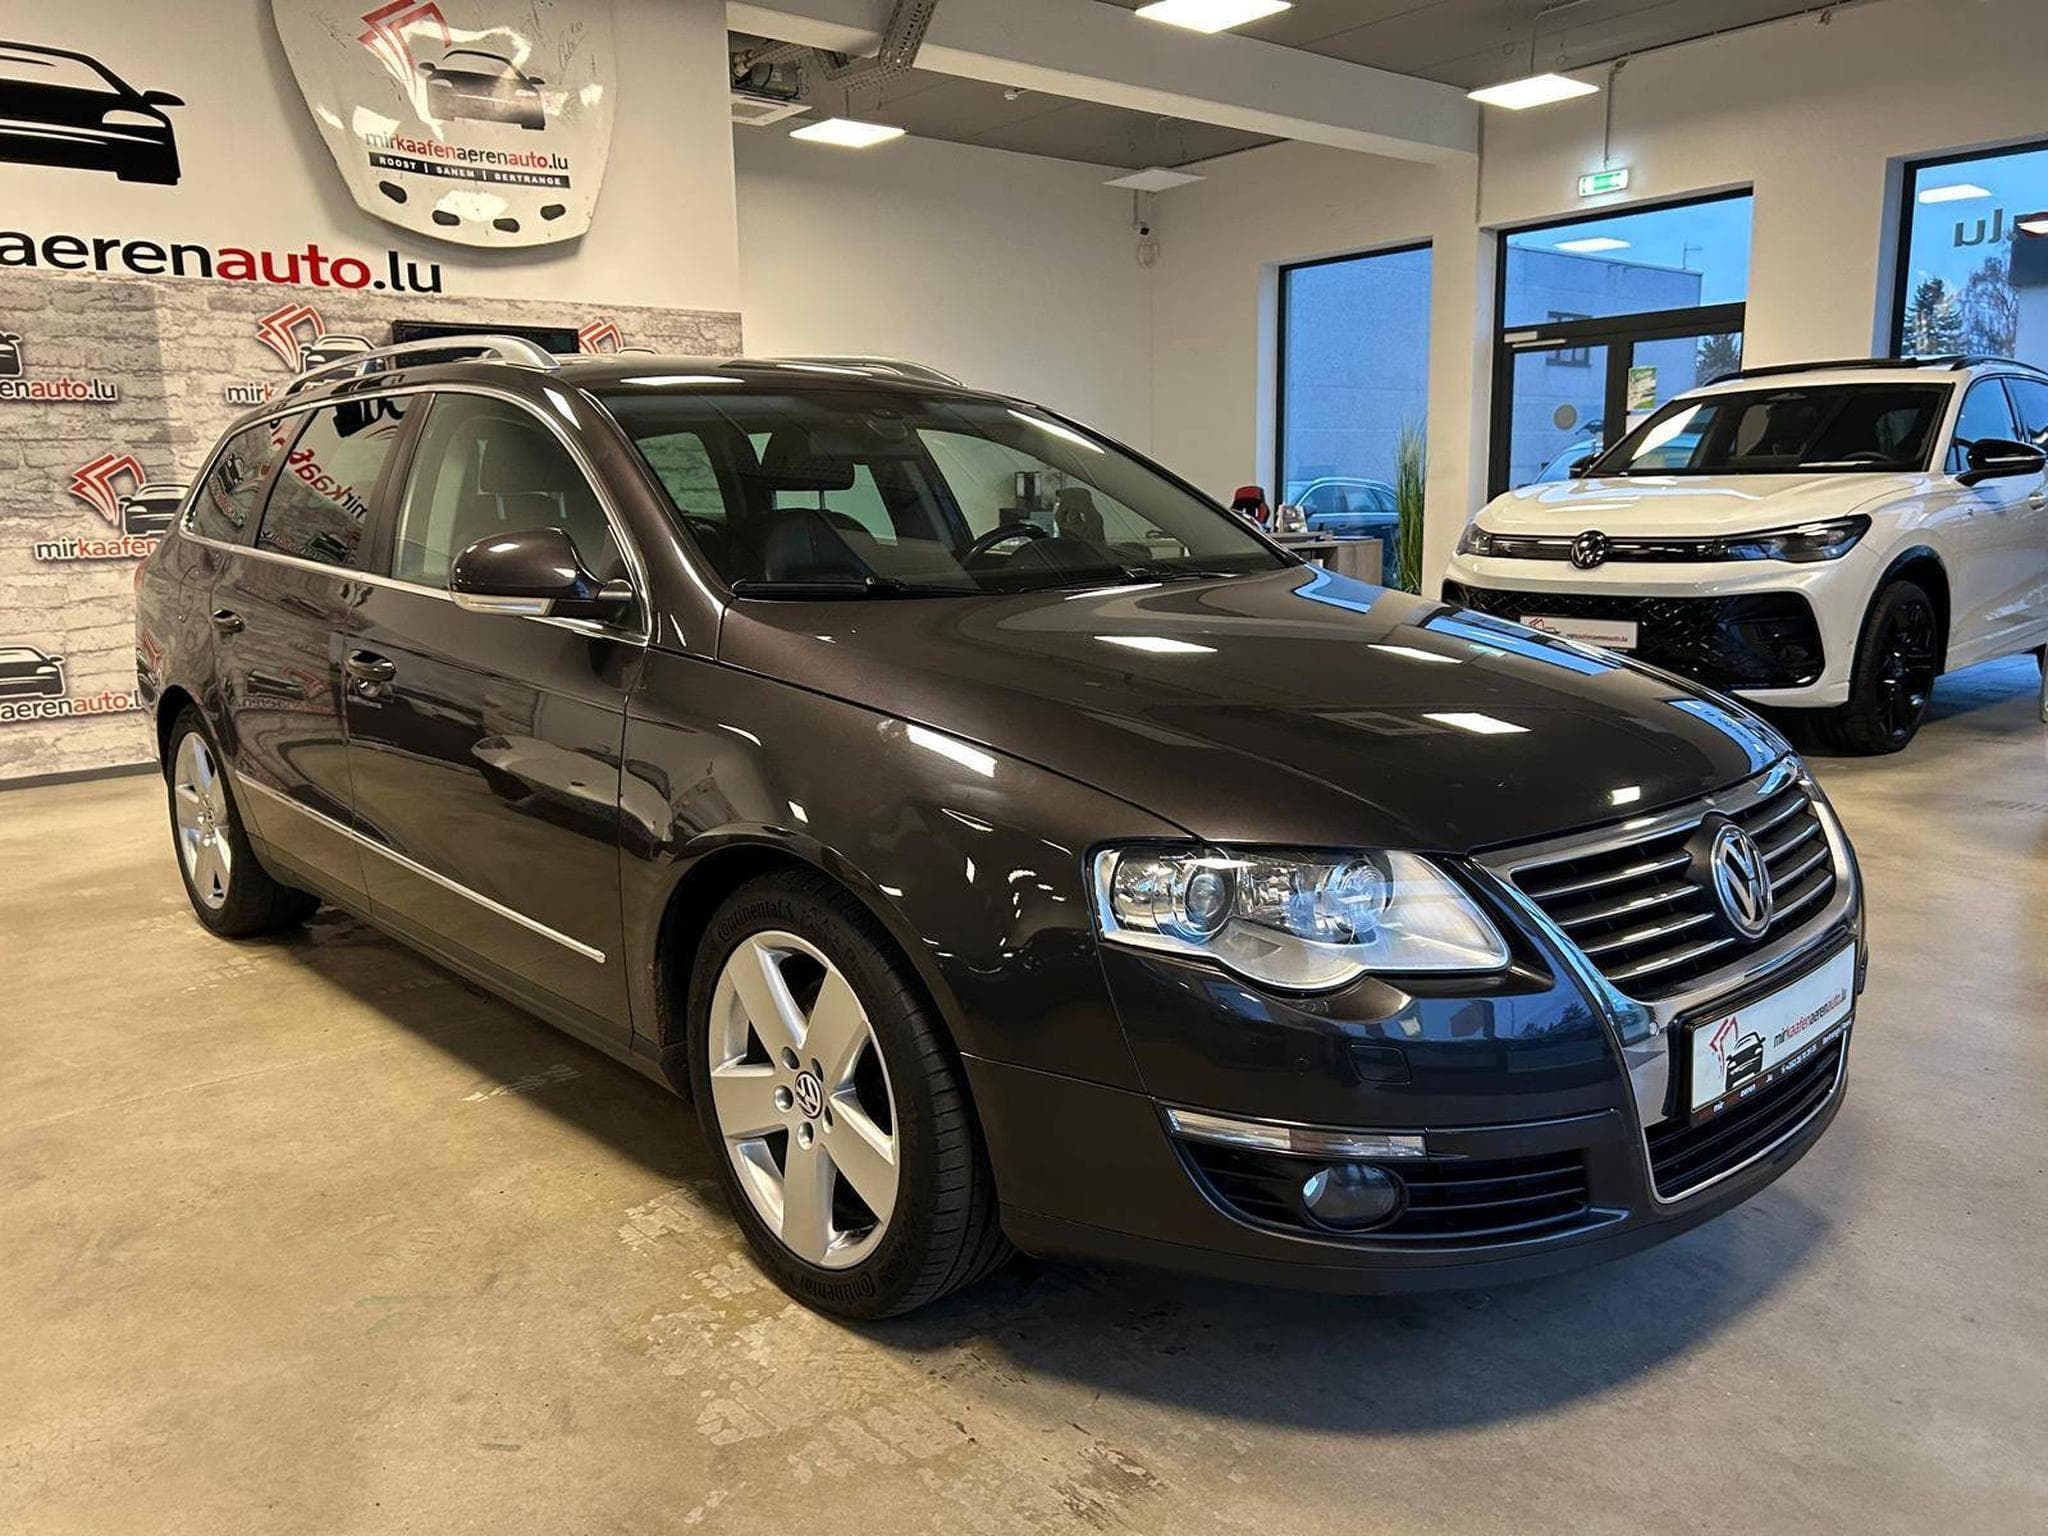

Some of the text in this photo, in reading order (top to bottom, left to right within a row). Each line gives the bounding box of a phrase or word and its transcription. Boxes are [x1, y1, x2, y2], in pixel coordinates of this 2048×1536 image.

[366, 131, 569, 170] mirkaafenaerenauto.lu
[379, 156, 562, 186] ROOST SANEM BERTRANGE
[0, 231, 442, 293] aerenauto.lu
[0, 378, 116, 399] enauto.lu
